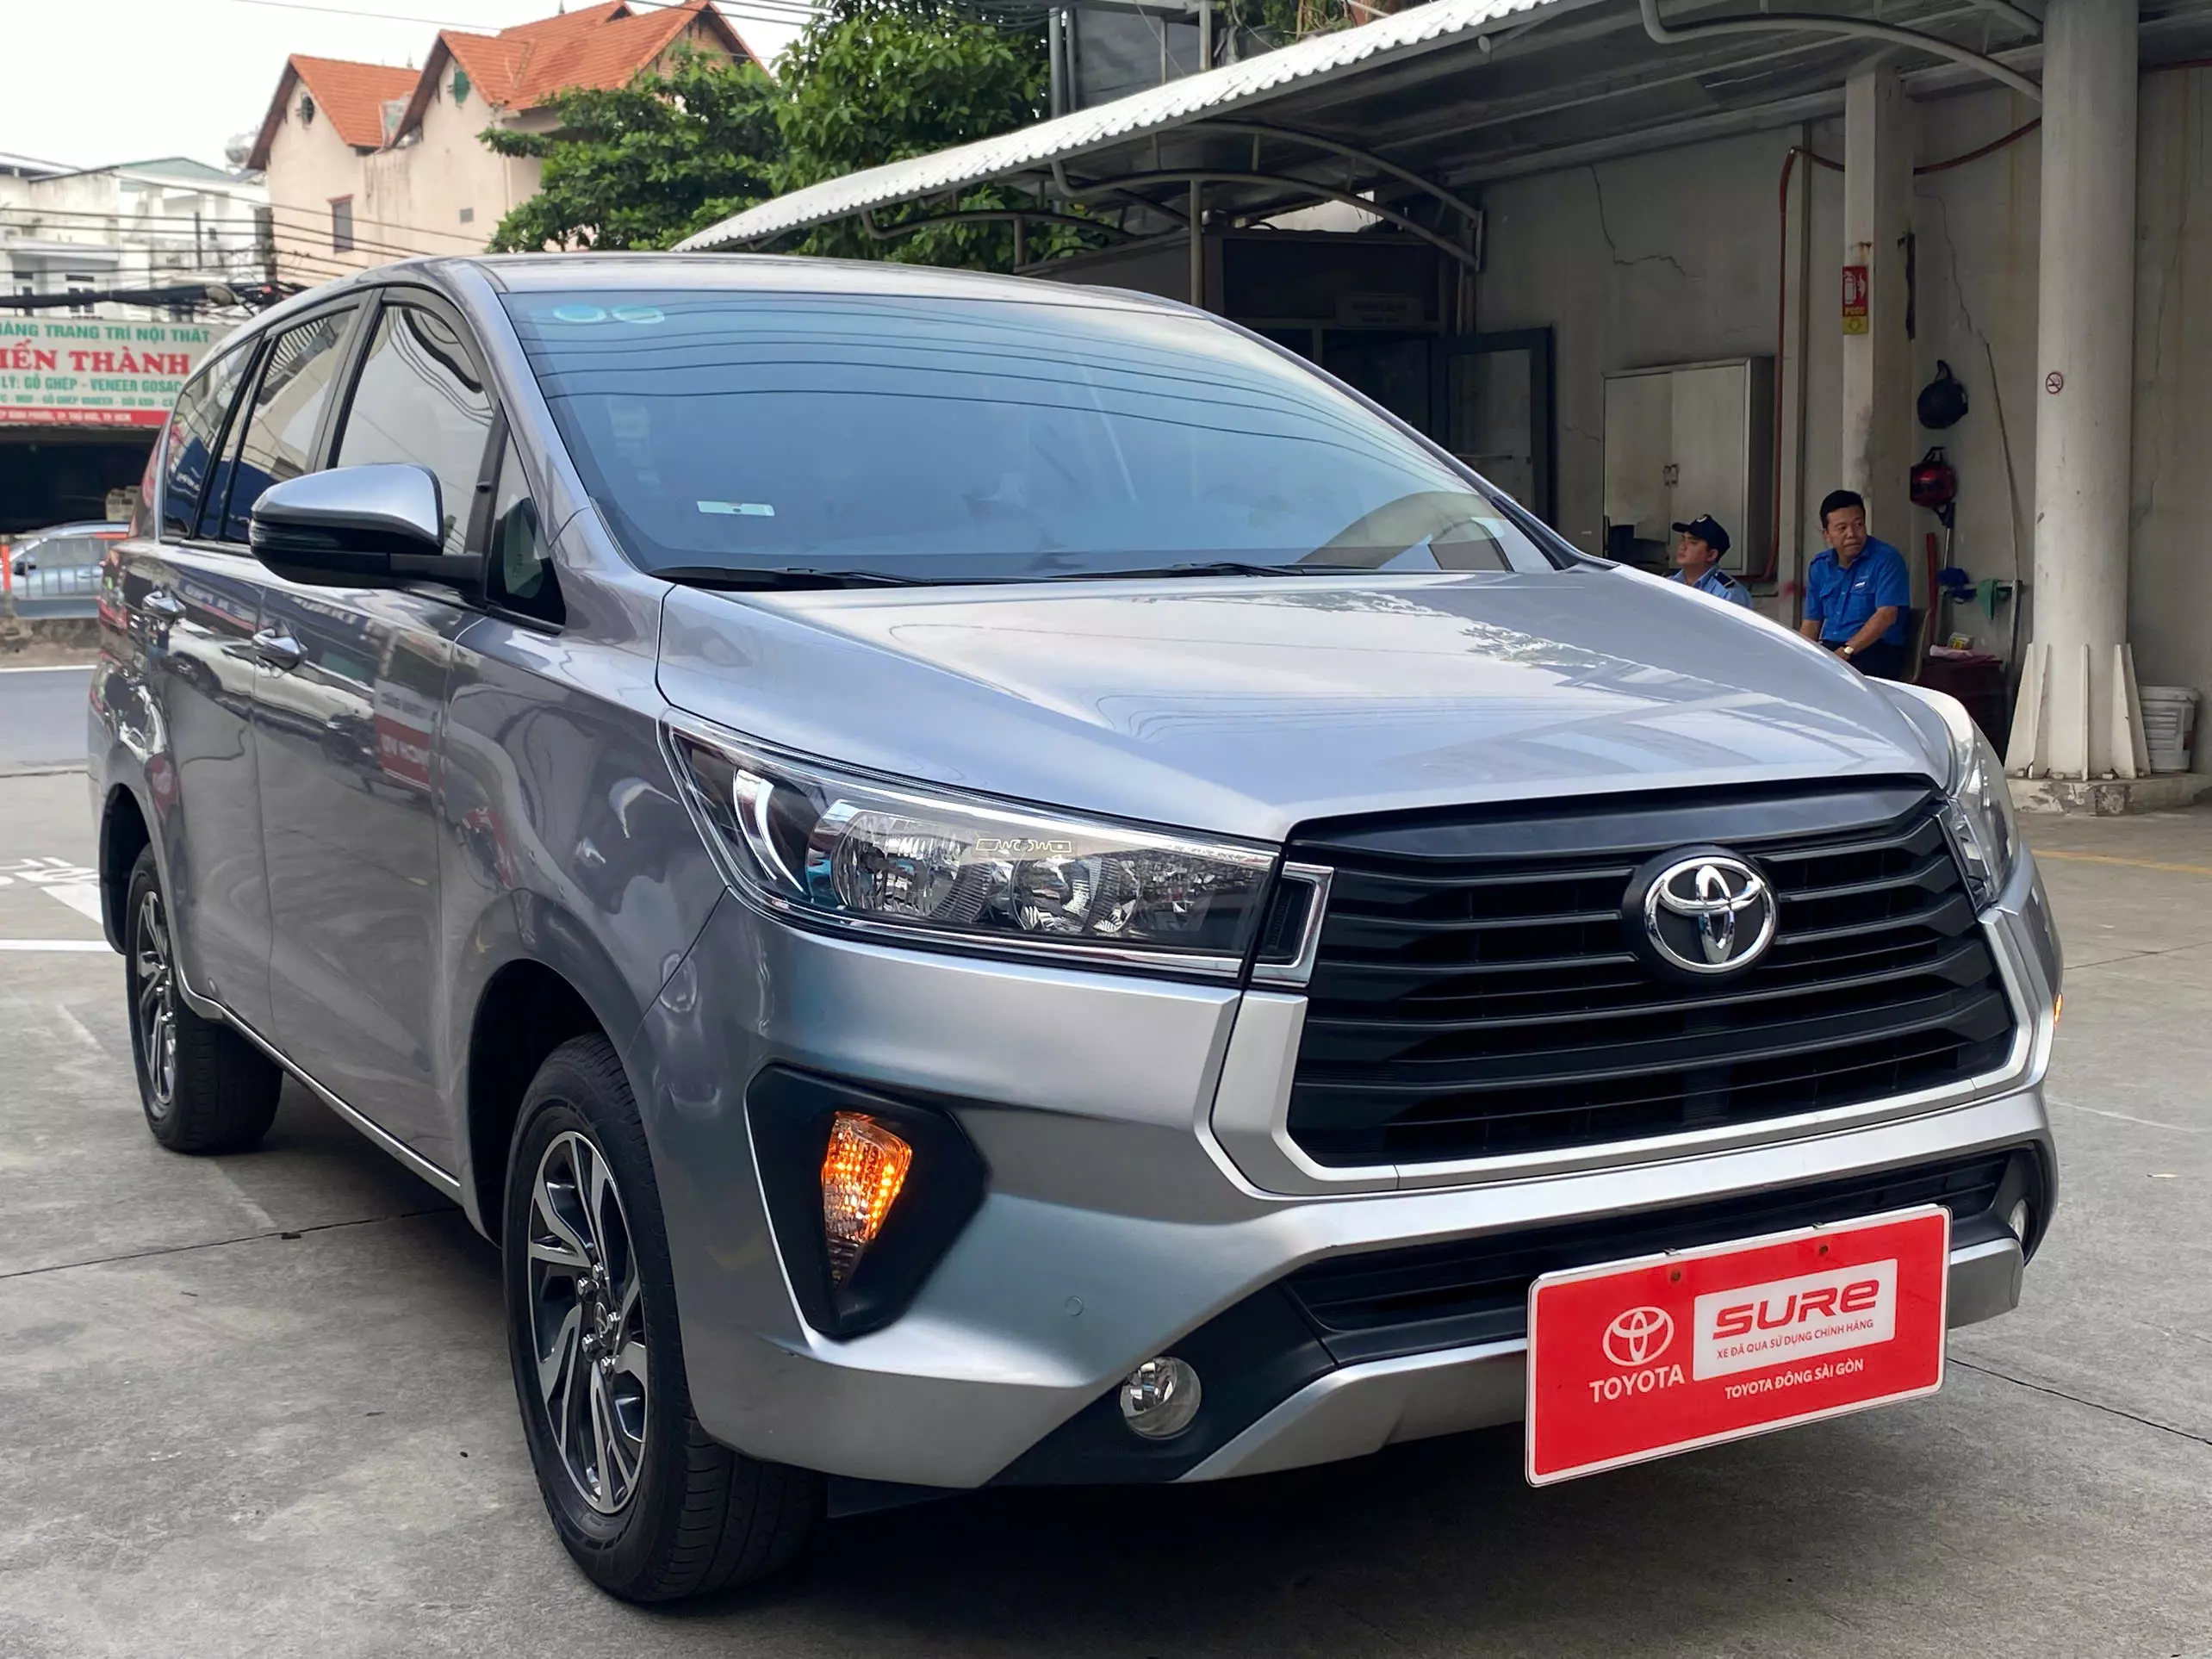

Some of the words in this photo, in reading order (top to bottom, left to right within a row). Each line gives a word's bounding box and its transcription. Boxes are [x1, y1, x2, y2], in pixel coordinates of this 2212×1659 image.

[44, 324, 100, 339] TRANG
[103, 325, 132, 341] TRÍ
[136, 325, 165, 345] NỘI
[68, 345, 191, 375] THÀNH
[90, 377, 138, 393] VENEER
[1717, 1347, 1729, 1359] XE
[1730, 1342, 1745, 1357] ĐÃ
[1746, 1340, 1768, 1355] QUA
[1770, 1334, 1783, 1348] SỬ
[1784, 1333, 1812, 1347] DỤNG
[1814, 1324, 1845, 1339] CHÍNH
[1589, 1364, 1685, 1403] TOYOTA
[1724, 1378, 1774, 1400] TOYOTA
[1774, 1370, 1813, 1389] ĐÔNG
[1814, 1363, 1834, 1381] SÀI
[1835, 1358, 1865, 1376] GÒN
